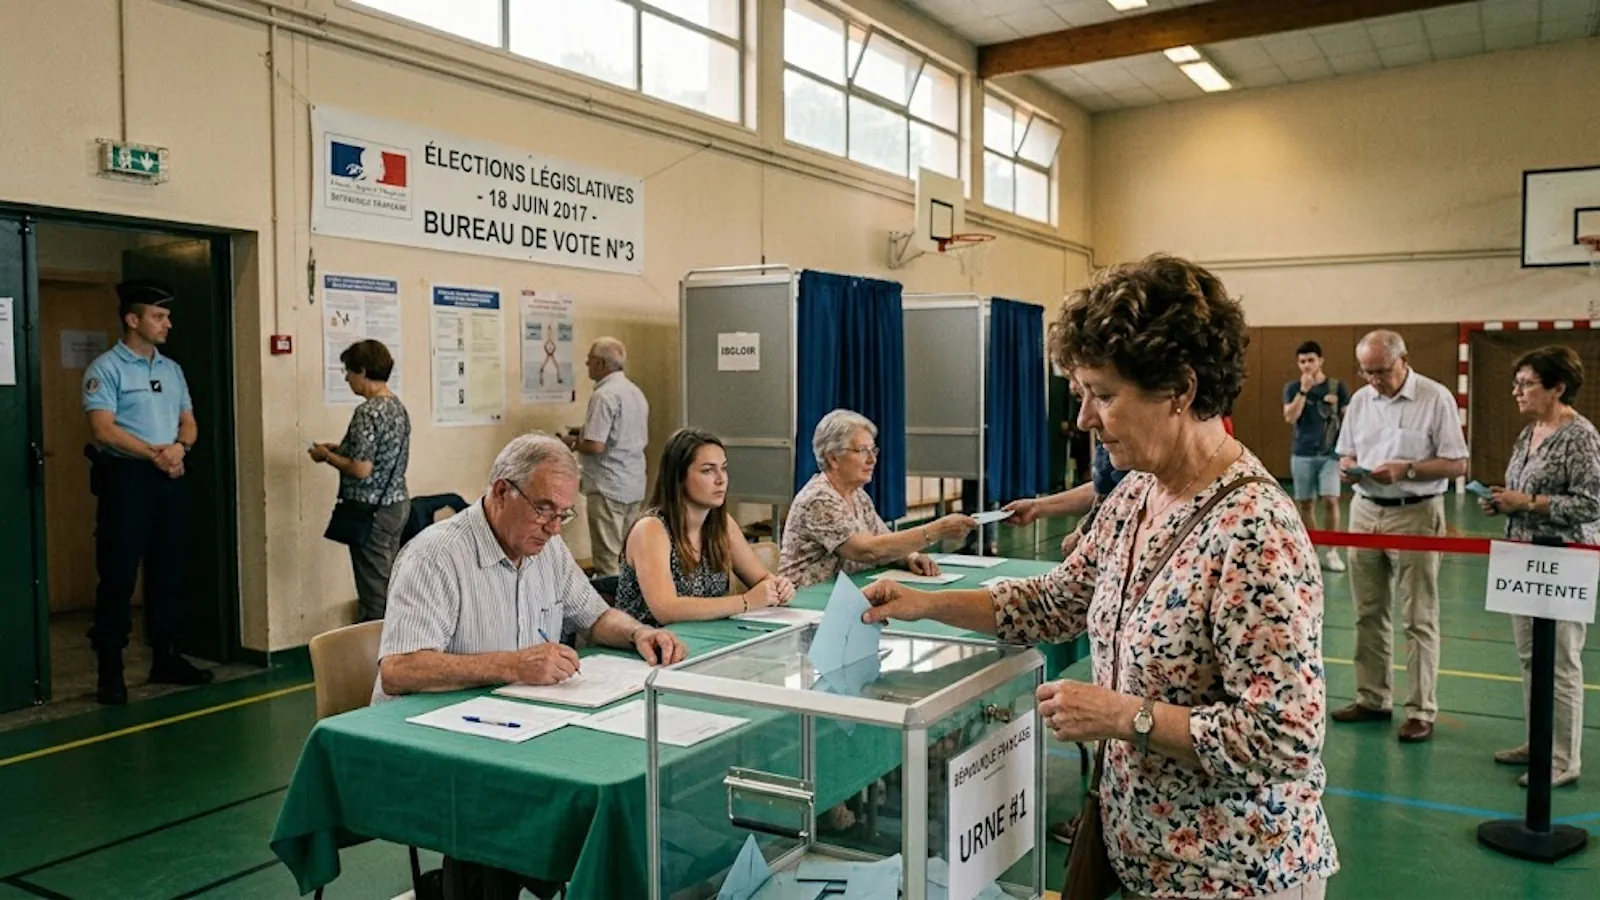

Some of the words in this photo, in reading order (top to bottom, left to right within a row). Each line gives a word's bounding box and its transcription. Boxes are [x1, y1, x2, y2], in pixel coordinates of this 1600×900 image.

[425, 140, 525, 183] ÉLECTIONS
[530, 165, 634, 204] LÉGISLATIVES
[489, 188, 507, 209] 18
[512, 193, 548, 216] JUIN
[553, 200, 588, 222] 2017
[424, 209, 514, 245] BUREAU
[522, 225, 547, 249] DE
[553, 229, 601, 257] VOTE
[606, 238, 634, 262] N°3
[1495, 578, 1588, 600] D'ATTENTE
[1526, 560, 1559, 575] FILE
[960, 804, 1005, 864] URNE
[1009, 788, 1028, 828] #1
